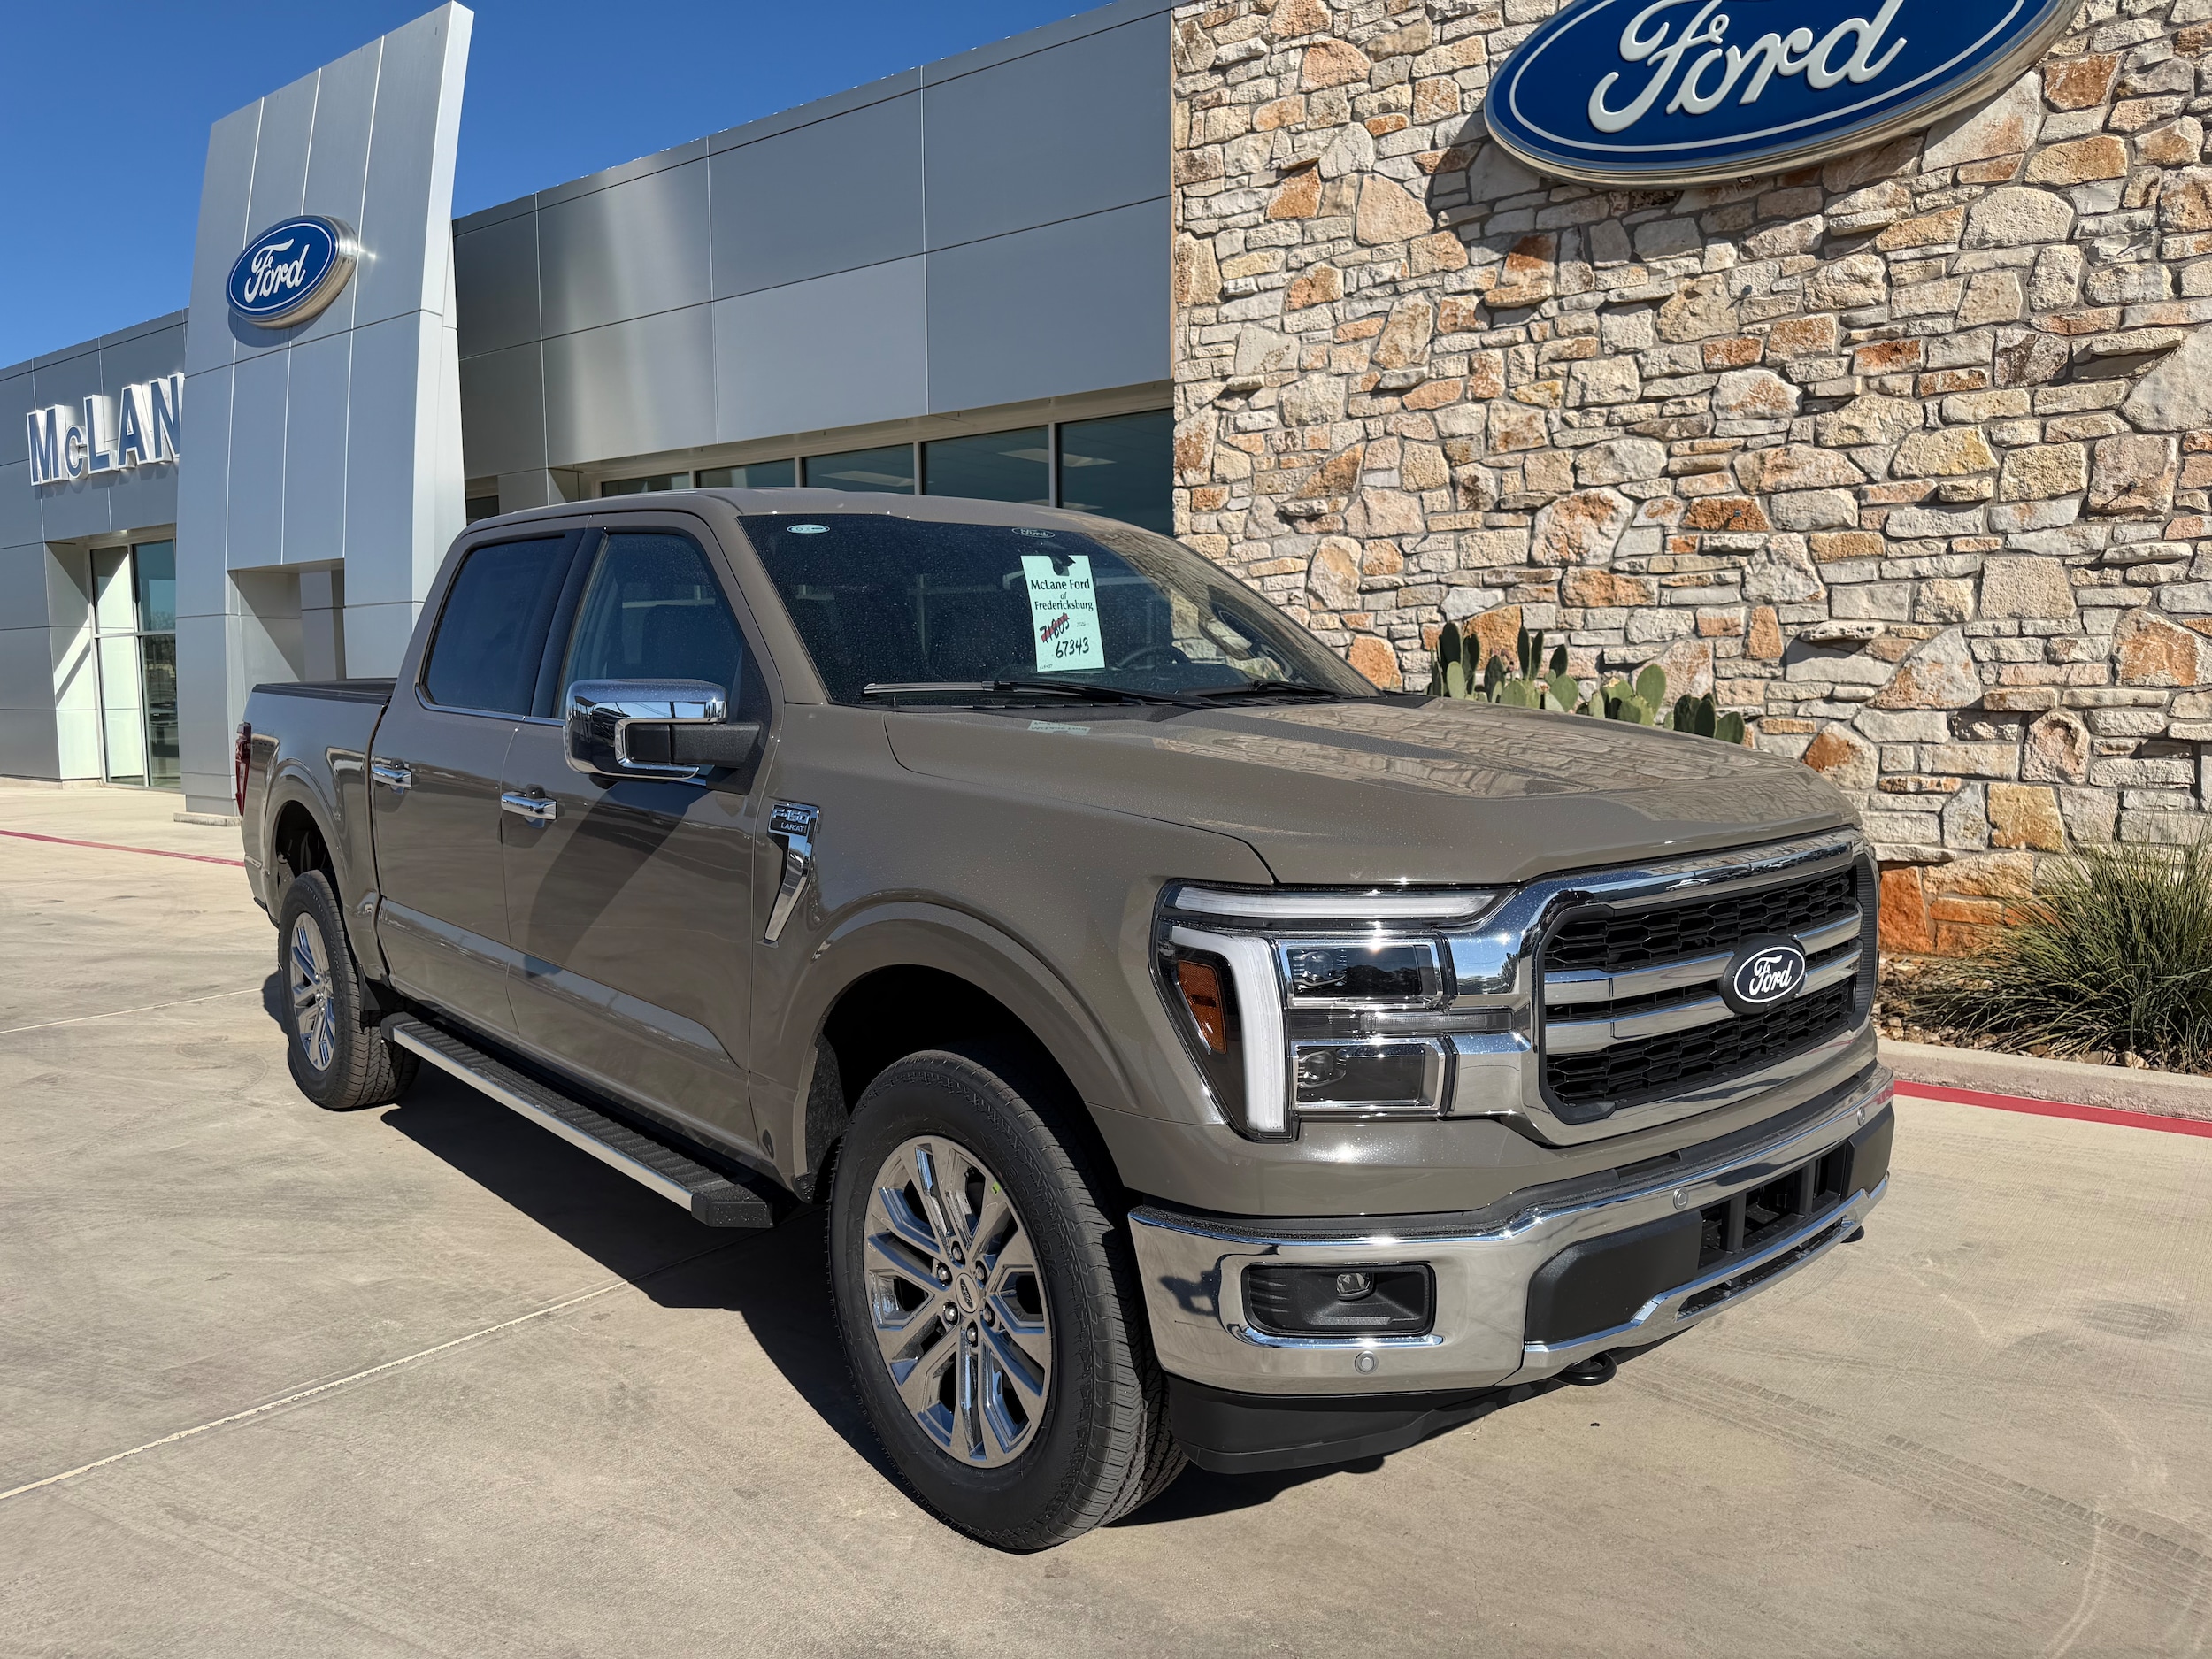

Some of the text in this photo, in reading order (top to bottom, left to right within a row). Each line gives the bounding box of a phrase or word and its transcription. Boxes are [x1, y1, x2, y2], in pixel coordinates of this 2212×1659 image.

[1588, 0, 1907, 133] Ford
[244, 238, 311, 303] Ford
[1030, 578, 1090, 590] McLane Ford
[1060, 591, 1067, 600] of
[1034, 599, 1094, 611] Fredericksburg
[1056, 637, 1089, 658] 67343
[772, 808, 810, 824] F-150
[780, 822, 805, 832] LARIAT
[1748, 955, 1793, 996] Ford
